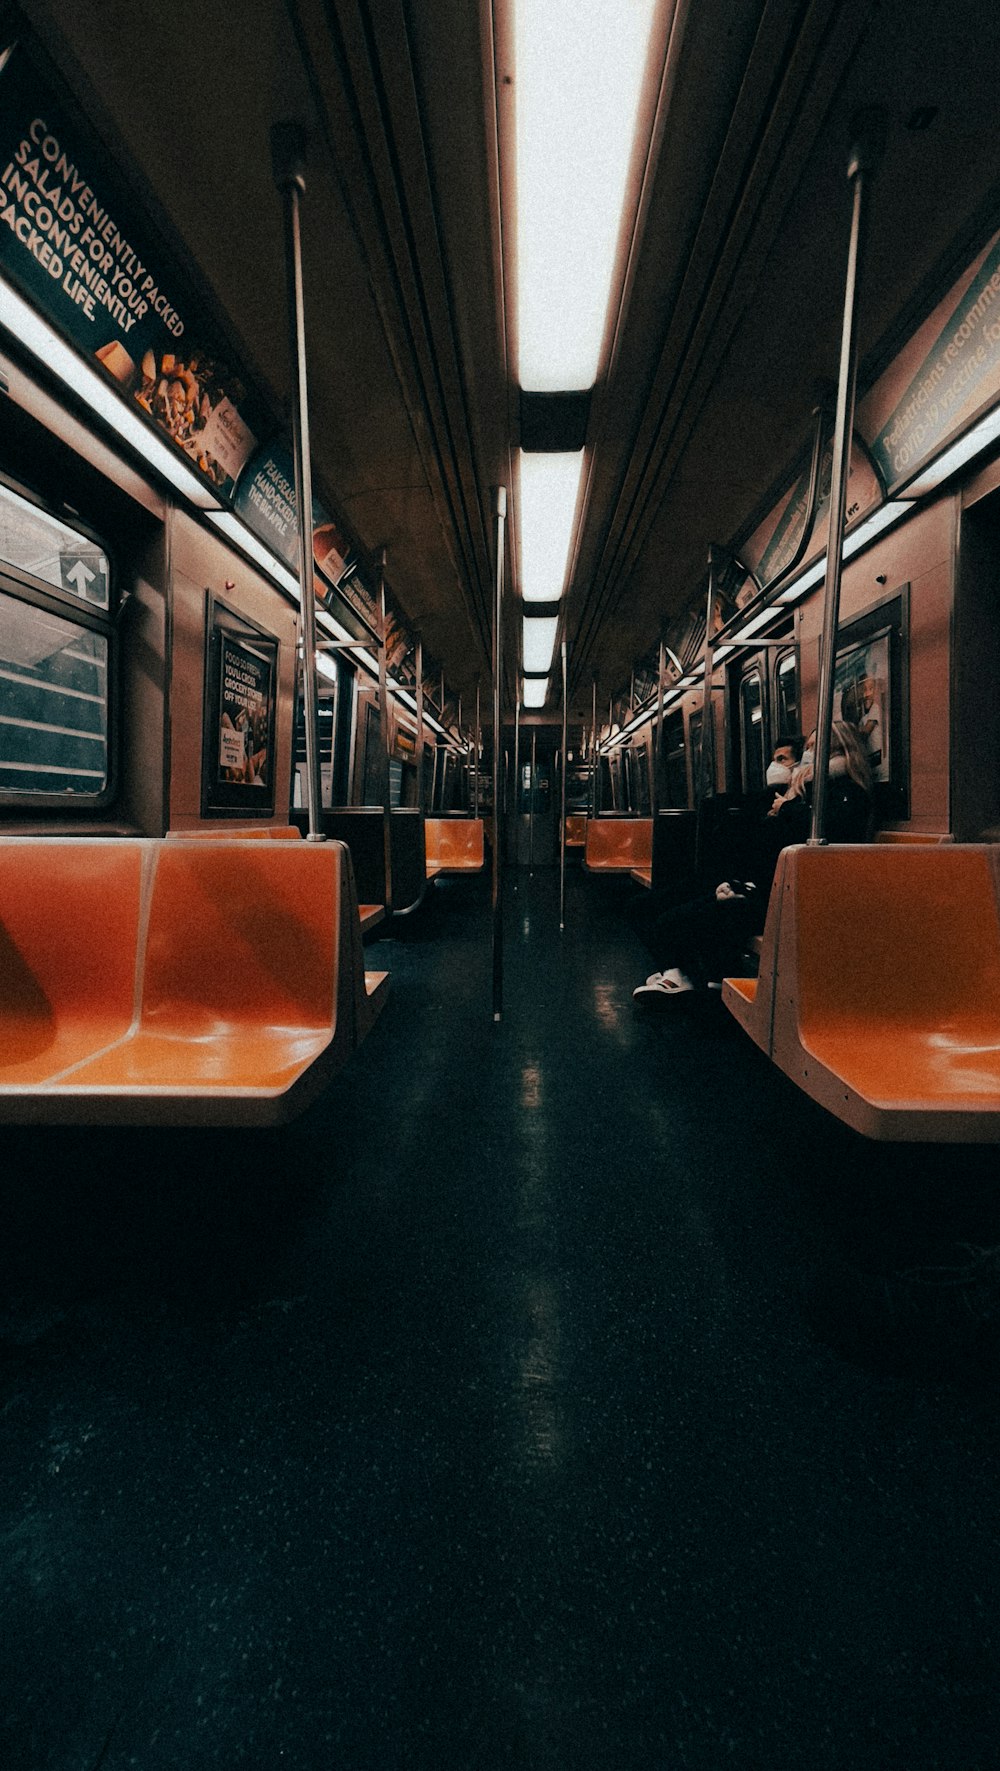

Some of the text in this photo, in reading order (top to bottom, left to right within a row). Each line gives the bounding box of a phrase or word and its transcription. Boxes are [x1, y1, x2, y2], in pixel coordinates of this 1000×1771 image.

[0, 161, 137, 334] INCONVENIENTLY
[14, 139, 149, 321] SALADS FOR YOUR
[29, 118, 185, 338] CONVENIENTLY PACKED
[62, 270, 96, 322] LIFE.
[882, 264, 1000, 456] Pediatricians recomme
[893, 400, 943, 474] COVID-19
[938, 347, 988, 414] vaccine
[248, 484, 263, 507] THE
[259, 498, 272, 517] BIG
[254, 471, 294, 522] HAND-PICKED
[847, 502, 860, 516] NYC
[225, 650, 240, 667] FOOD
[239, 658, 247, 670] SO
[241, 672, 256, 687] CROSS
[224, 690, 235, 702] OFF
[234, 694, 248, 708] YOUR
[225, 677, 263, 702] GROCERY STORES
